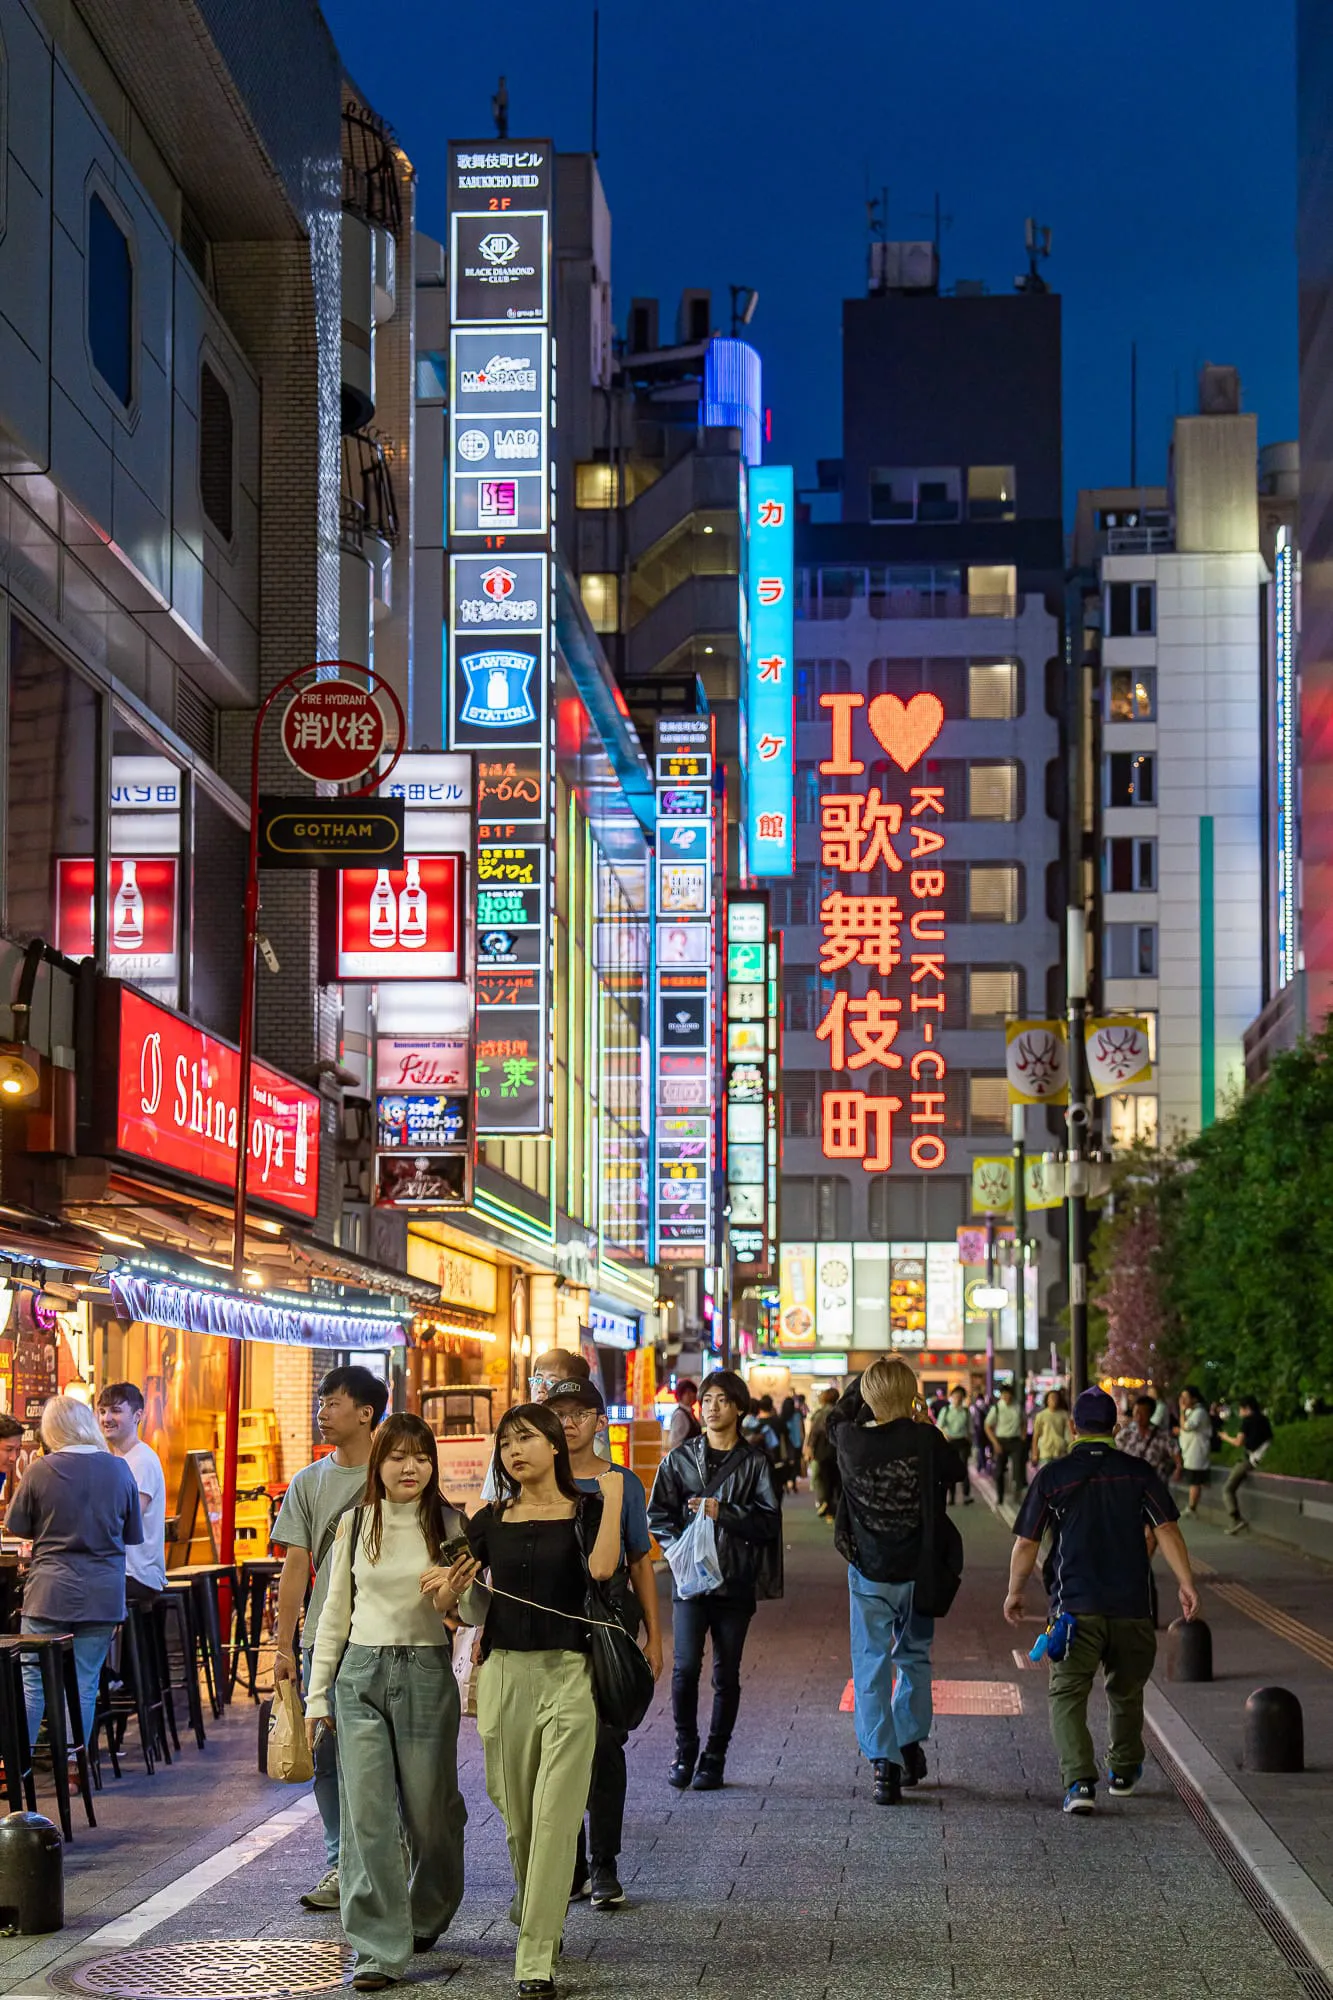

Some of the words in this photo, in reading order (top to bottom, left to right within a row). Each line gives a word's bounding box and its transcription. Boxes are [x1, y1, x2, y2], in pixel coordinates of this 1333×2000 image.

[457, 153, 543, 169] 歌舞伎町ビル
[488, 197, 512, 211] 2F
[484, 536, 507, 549] 1F
[468, 655, 529, 672] LAWSON
[757, 499, 785, 841] カラオケ館
[301, 693, 322, 705] FIRE
[325, 693, 368, 706] HYDRANT
[468, 705, 529, 722] STATION
[293, 711, 377, 750] 消火栓
[820, 692, 865, 775] I
[389, 783, 463, 800] 森田ビル
[293, 823, 373, 837] GOTHAM
[815, 788, 902, 1172] 歌舞伎町
[910, 787, 945, 1169] KABUKI-CHO
